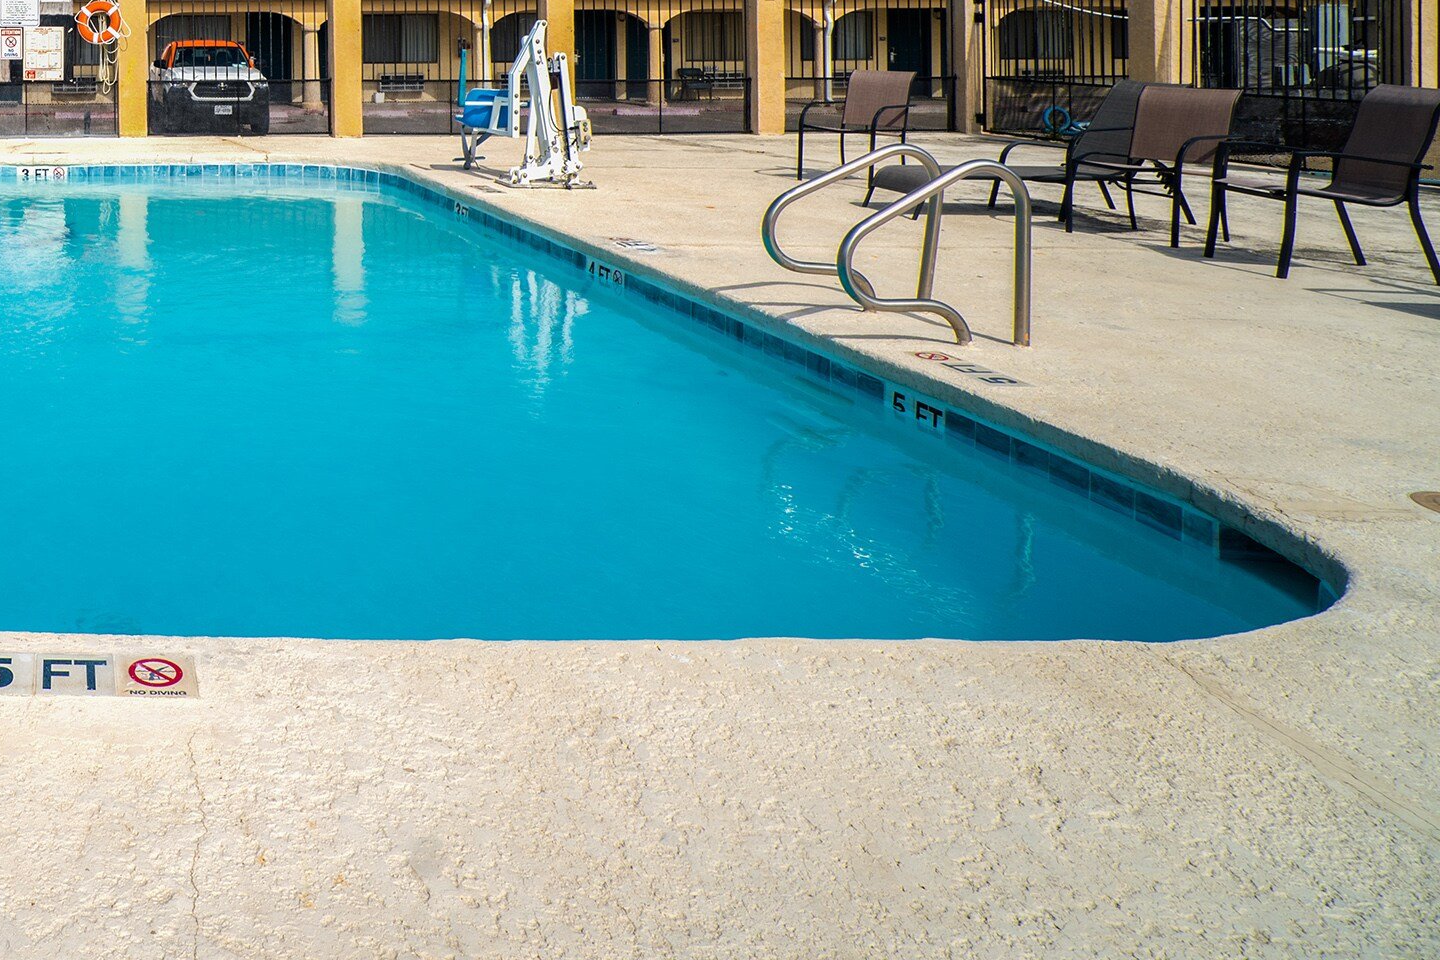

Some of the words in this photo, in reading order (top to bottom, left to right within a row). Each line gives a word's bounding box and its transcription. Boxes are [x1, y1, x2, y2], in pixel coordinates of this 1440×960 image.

[22, 168, 29, 181] 3
[35, 168, 49, 181] FT
[599, 265, 611, 280] FT
[892, 391, 906, 413] 5
[916, 401, 943, 428] FT
[42, 659, 107, 690] FT
